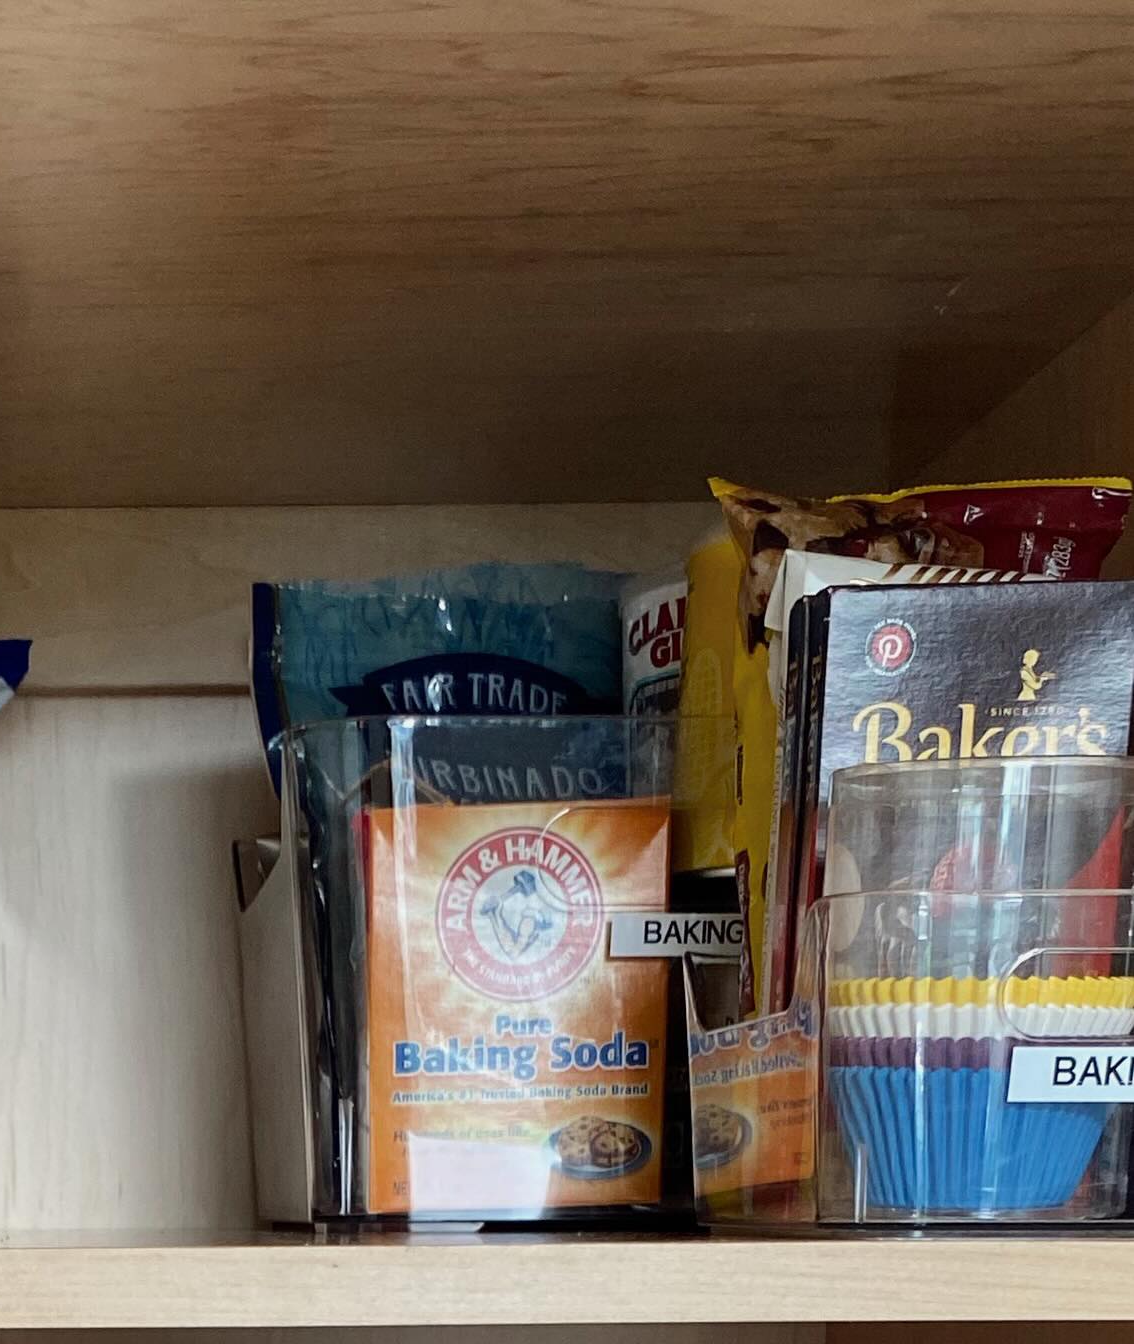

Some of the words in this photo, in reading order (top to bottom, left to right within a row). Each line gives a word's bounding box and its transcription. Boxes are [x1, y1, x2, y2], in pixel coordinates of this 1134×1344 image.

[380, 674, 454, 712] FAIR
[466, 672, 568, 715] TRADE
[852, 701, 1107, 764] Baker's
[415, 757, 603, 798] URBINADO
[446, 865, 482, 931] ARM
[478, 849, 501, 873] &
[505, 836, 594, 928] HAMMER
[643, 919, 743, 945] BAKING
[495, 1014, 554, 1035] Pure
[394, 1036, 539, 1082] Baking
[549, 1031, 650, 1070] Soda
[529, 1084, 572, 1101] Baking
[576, 1083, 607, 1097] Soda
[611, 1082, 649, 1096] Brand
